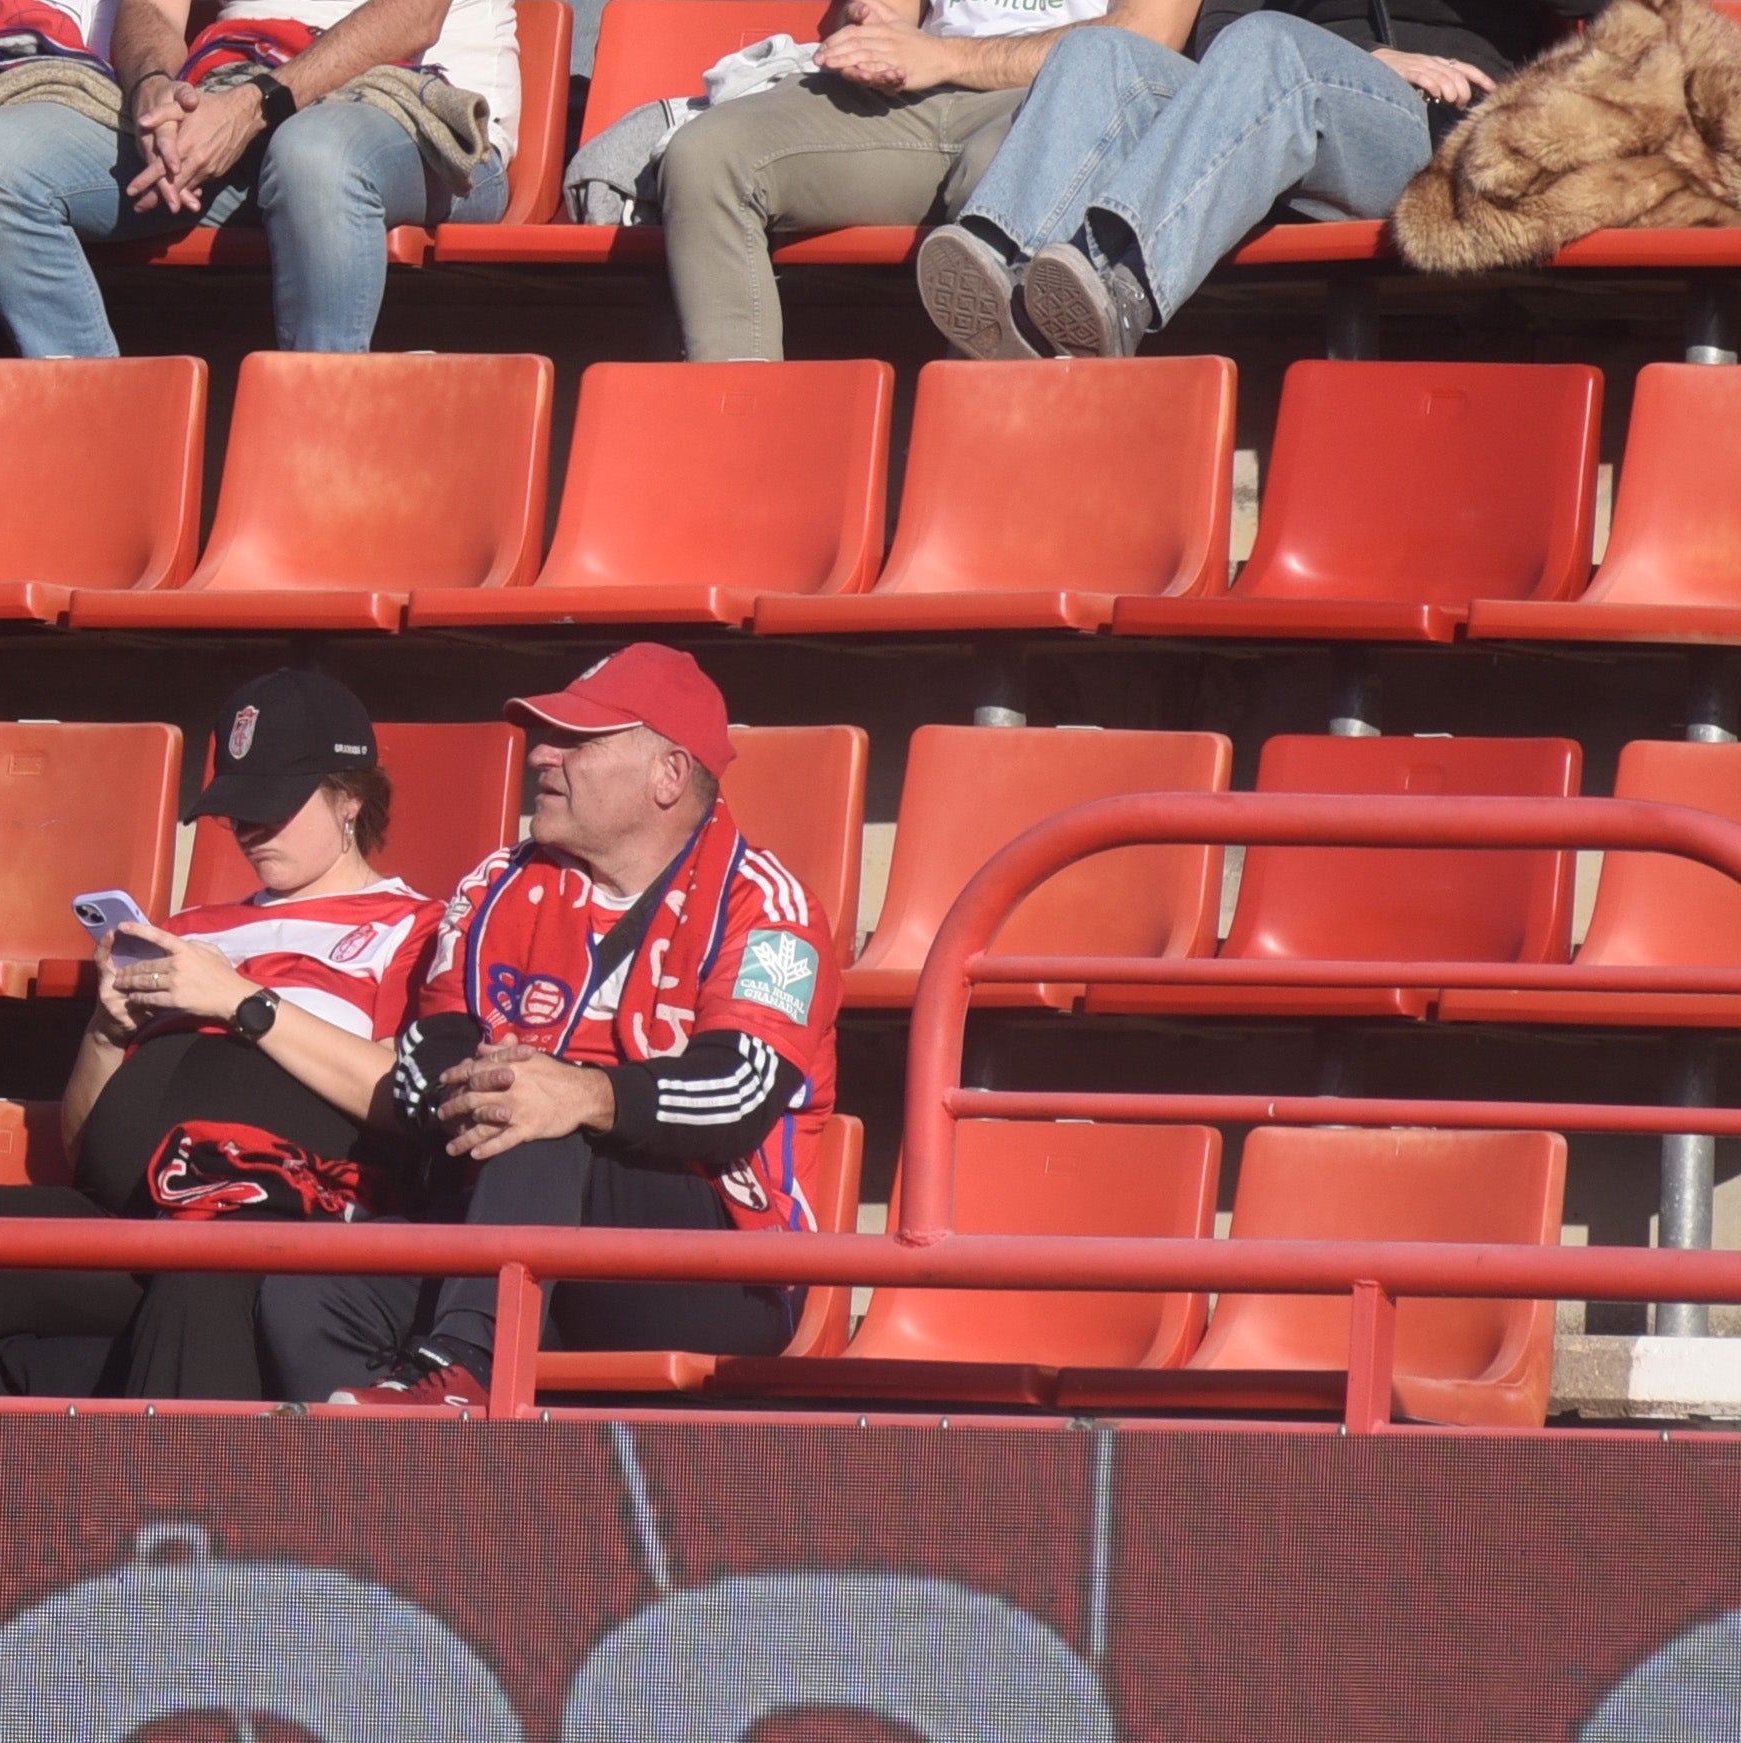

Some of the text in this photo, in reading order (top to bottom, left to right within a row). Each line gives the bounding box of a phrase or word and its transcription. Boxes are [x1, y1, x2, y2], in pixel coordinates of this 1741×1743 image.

[740, 978, 806, 1015] CAJA RURAL
[743, 989, 800, 1021] GRANADA
